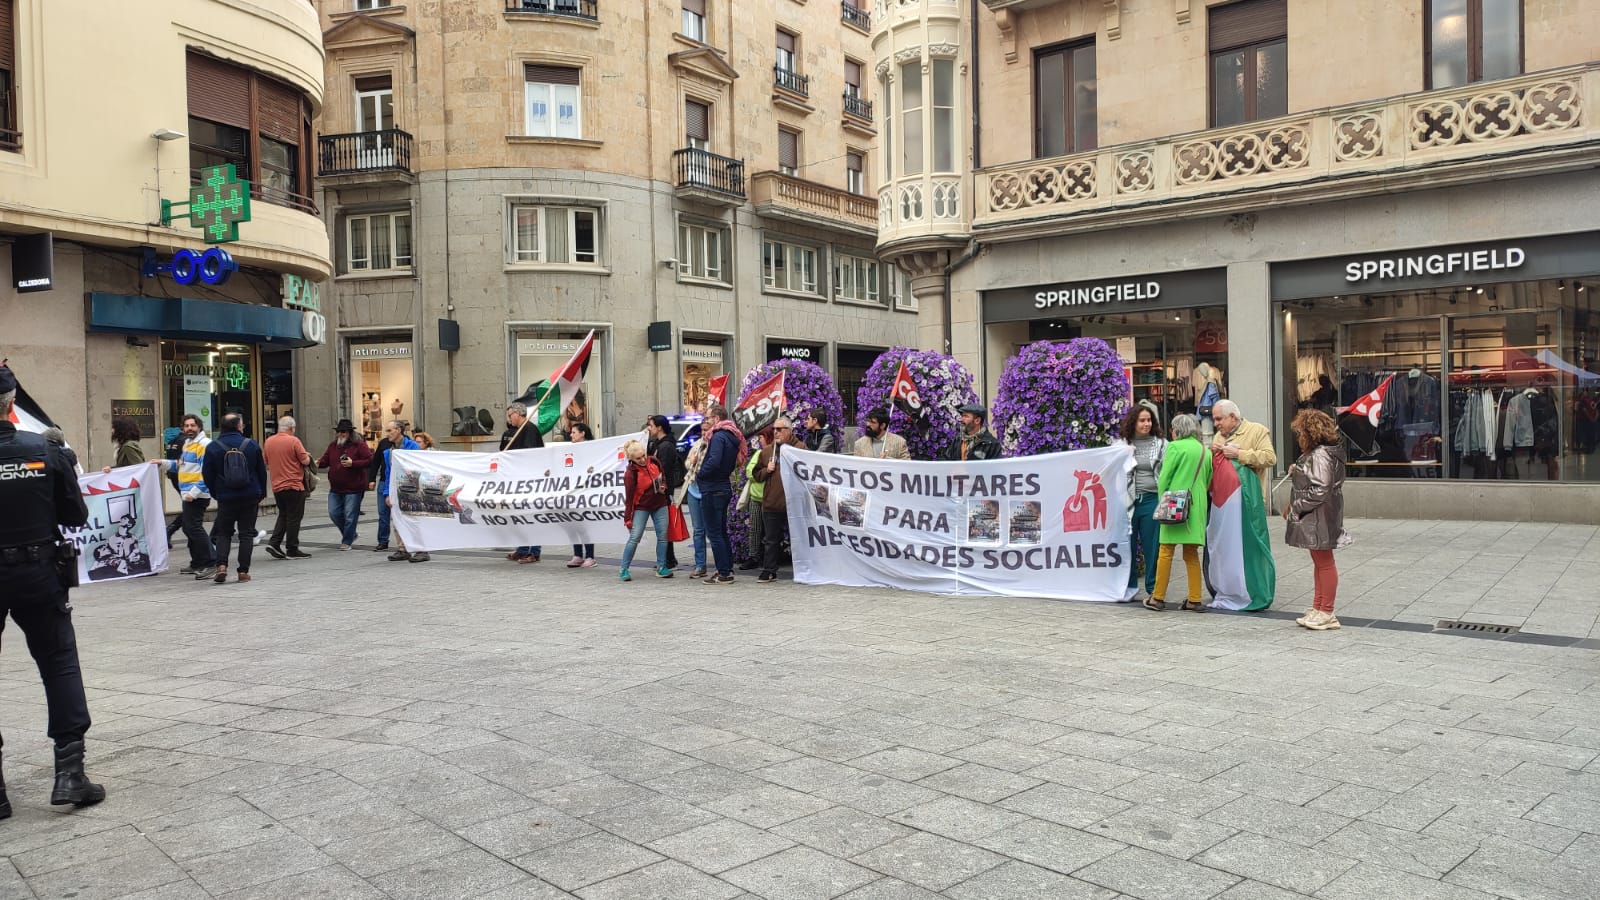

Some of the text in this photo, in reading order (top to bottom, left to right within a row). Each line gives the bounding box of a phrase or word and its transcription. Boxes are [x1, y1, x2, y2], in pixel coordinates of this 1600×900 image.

[1345, 248, 1525, 282] SPRINGFIELD
[1035, 282, 1160, 308] SPRINGFIELD
[523, 343, 598, 351] intimissii
[781, 348, 810, 357] MANGO
[899, 380, 925, 418] CG
[477, 476, 570, 496] ¡PALESTINA
[793, 461, 1040, 497] GASTOS MILITARES
[475, 490, 625, 510] NO A LA OCUPACIÓN
[481, 514, 507, 525] NO
[510, 514, 534, 525] AL
[882, 506, 950, 533] PARA
[808, 525, 1122, 570] NECESIDADES SOCIALES
